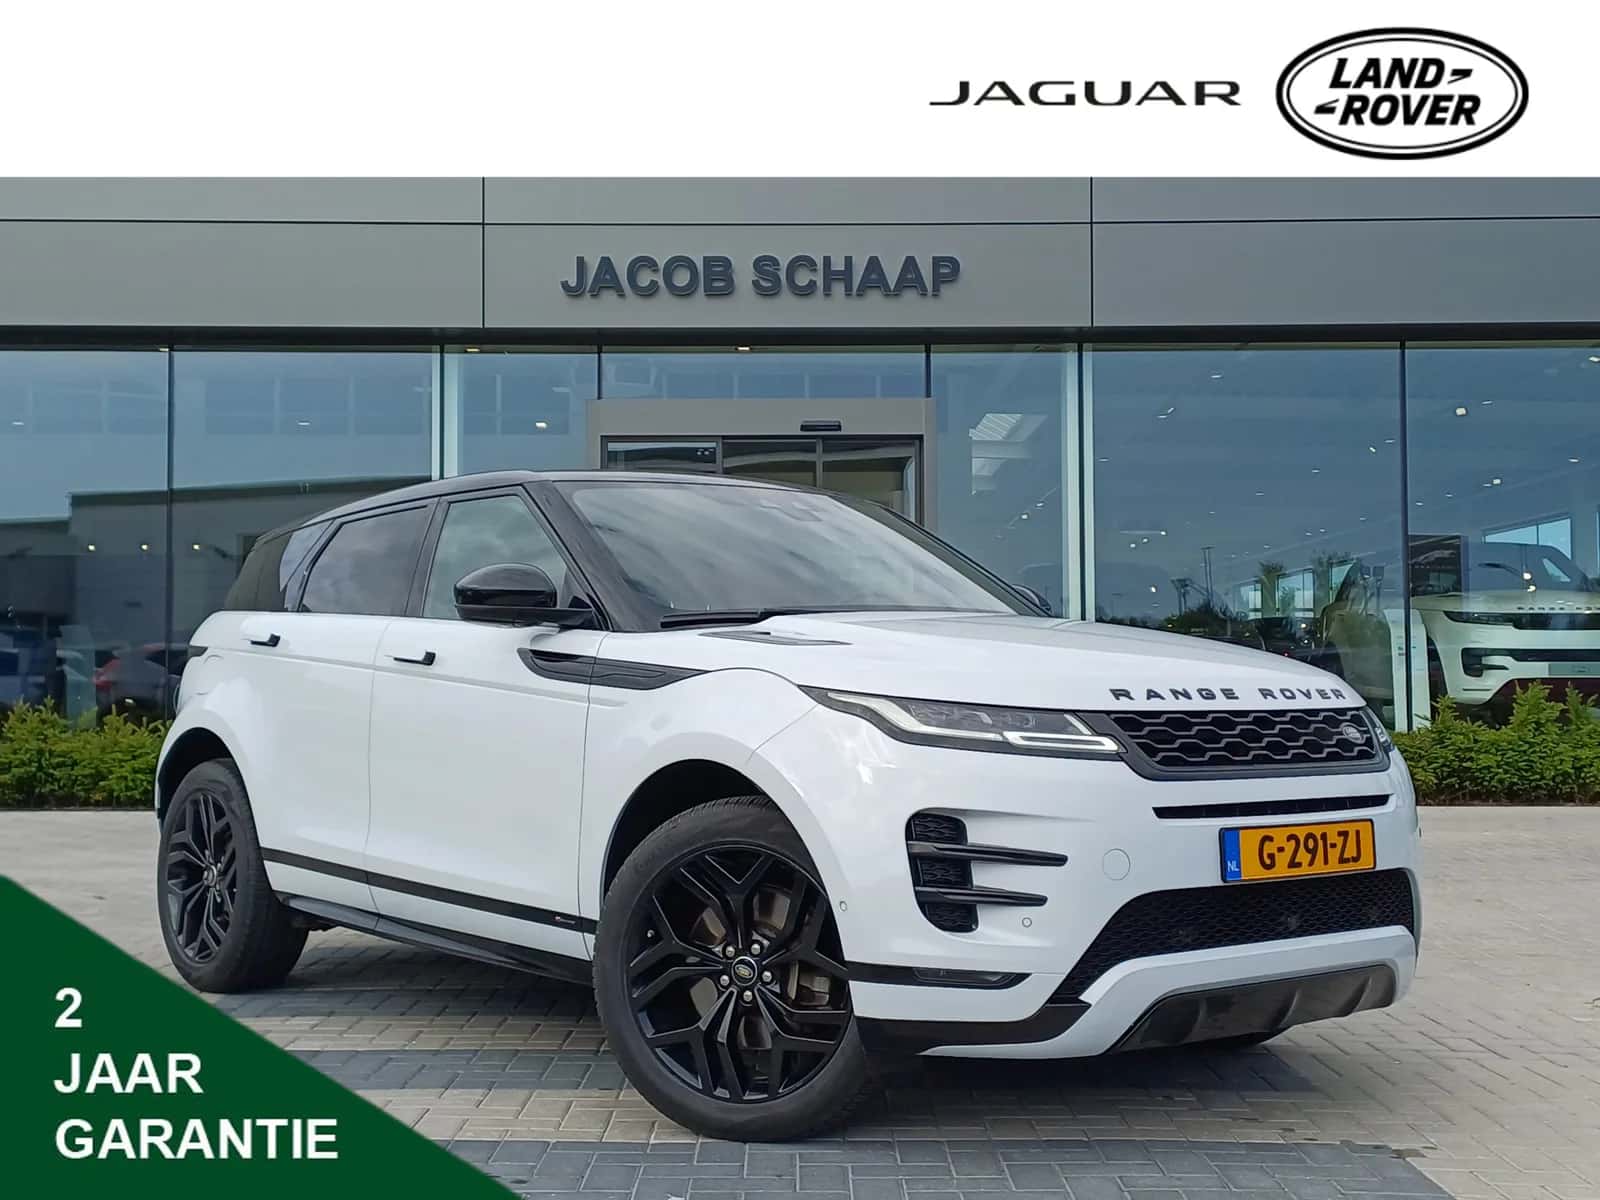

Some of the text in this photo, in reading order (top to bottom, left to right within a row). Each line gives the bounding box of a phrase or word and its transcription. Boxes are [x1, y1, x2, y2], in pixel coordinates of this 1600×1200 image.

[560, 255, 961, 297] JACOB SCHAAP
[1109, 687, 1347, 701] RANGE ROVER
[1258, 829, 1362, 871] G-291-ZJ
[1227, 860, 1240, 872] NL
